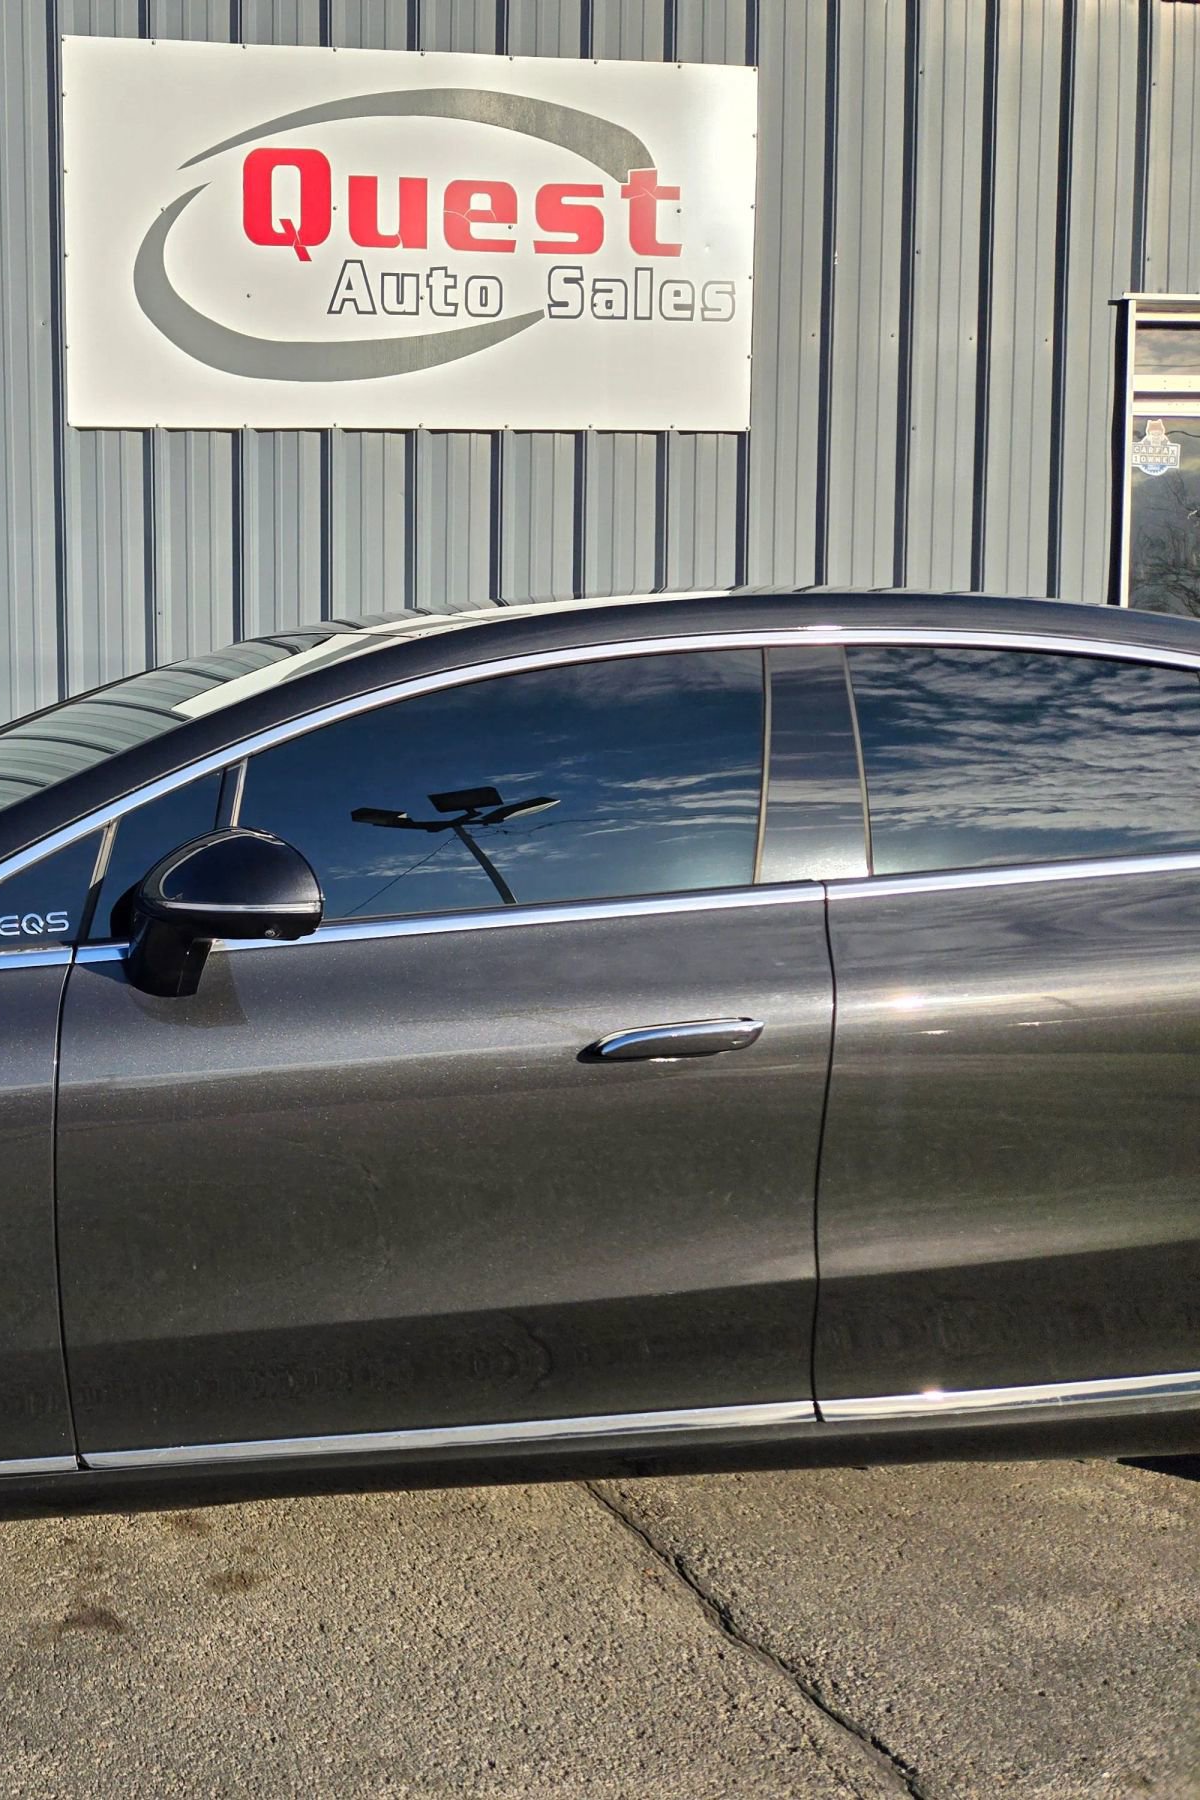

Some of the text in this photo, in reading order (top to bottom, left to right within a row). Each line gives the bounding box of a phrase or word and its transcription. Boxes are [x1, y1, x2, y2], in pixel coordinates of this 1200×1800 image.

[242, 147, 683, 262] Quest
[327, 259, 736, 322] Auto Sales
[1133, 445, 1177, 456] CARFAX
